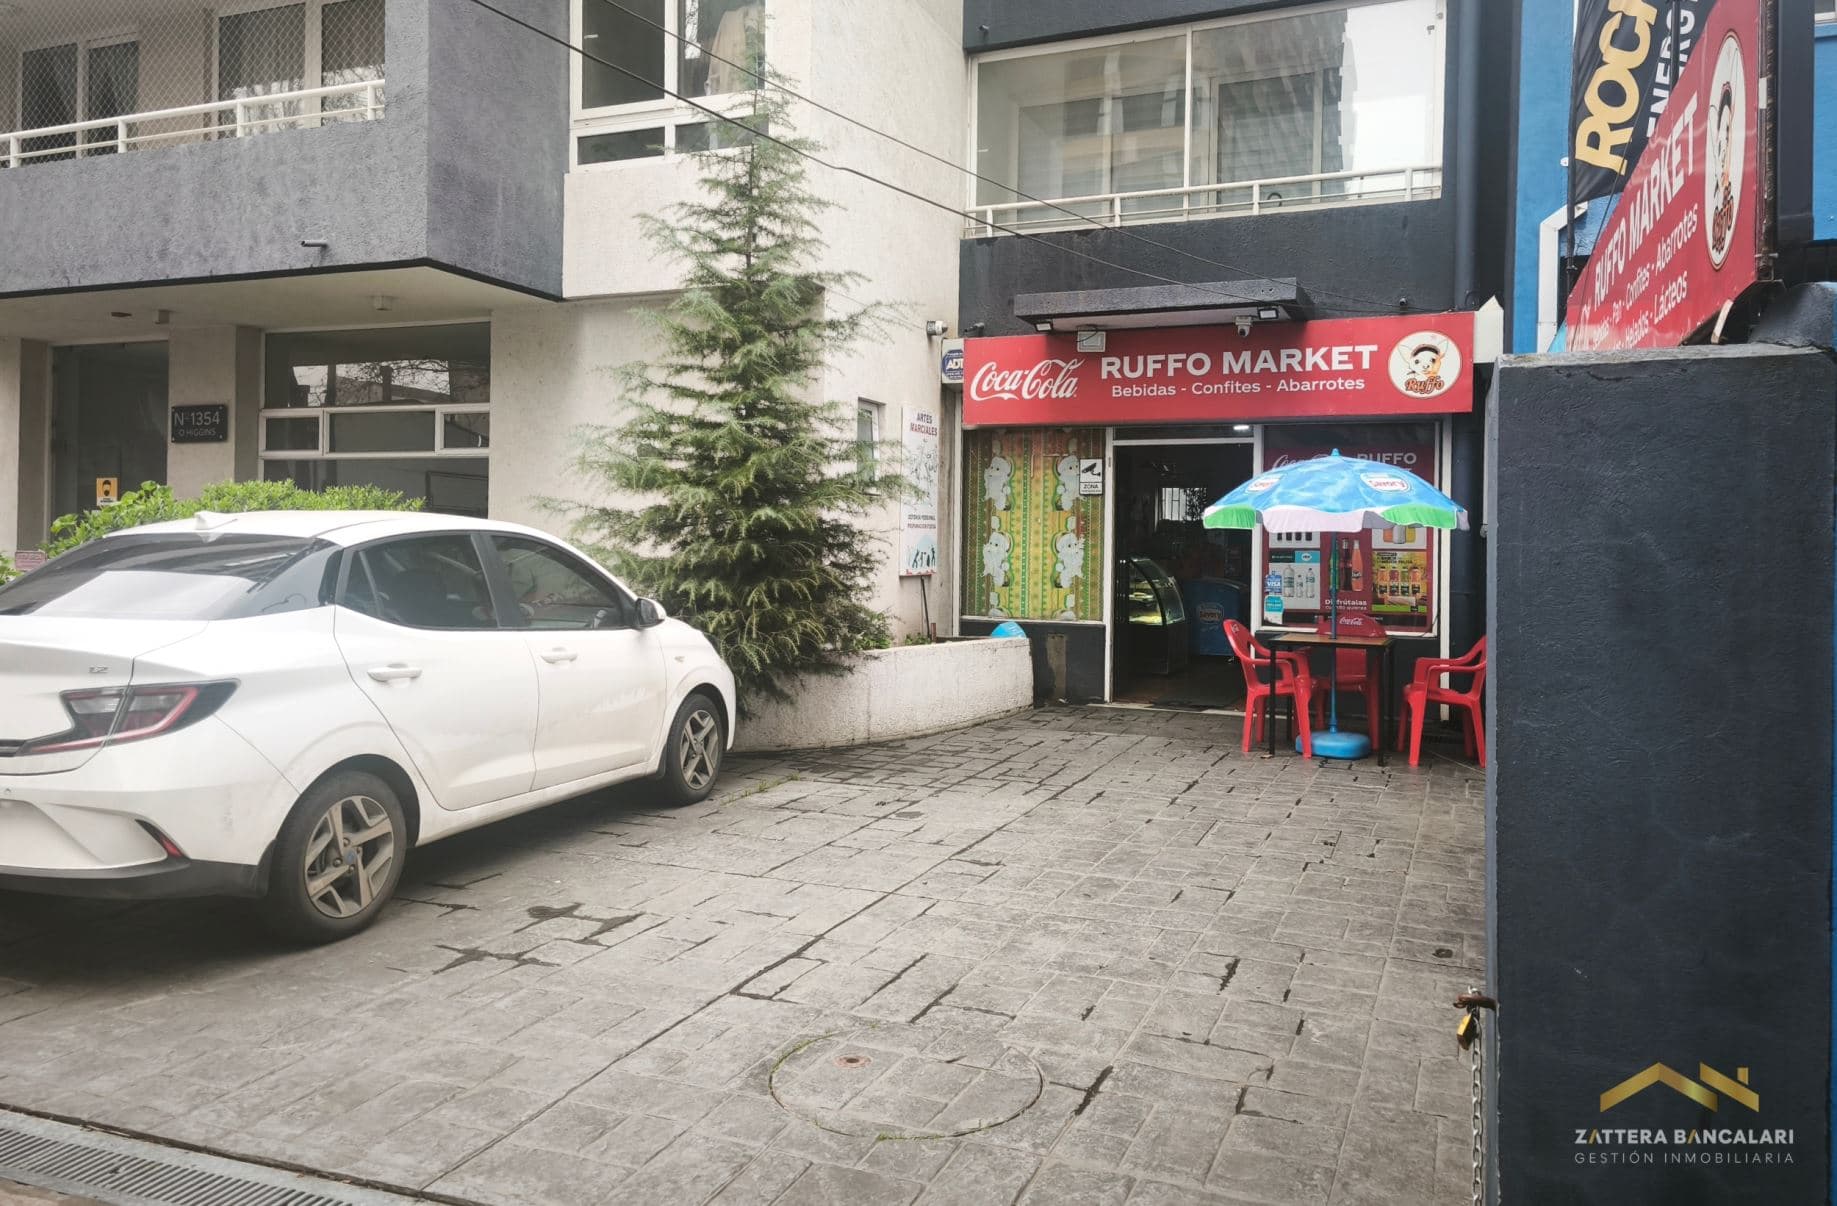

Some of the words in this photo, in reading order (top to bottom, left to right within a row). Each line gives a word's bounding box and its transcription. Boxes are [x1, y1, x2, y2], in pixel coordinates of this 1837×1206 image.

[1594, 216, 1626, 311] RUFFO
[1628, 90, 1698, 261] MARKET
[1655, 202, 1699, 275] Abarrotes
[1653, 270, 1688, 325] Lácteos
[970, 358, 1086, 402] Coca-Cola
[1101, 352, 1212, 380] RUFFO
[1222, 344, 1379, 375] MARKET
[1111, 384, 1177, 398] Bebidas
[1191, 379, 1262, 395] Confites
[1276, 376, 1366, 393] Abarrotes
[910, 423, 938, 436] MARCIALES
[917, 413, 932, 424] ARTES
[1324, 599, 1368, 607] Difrútalas
